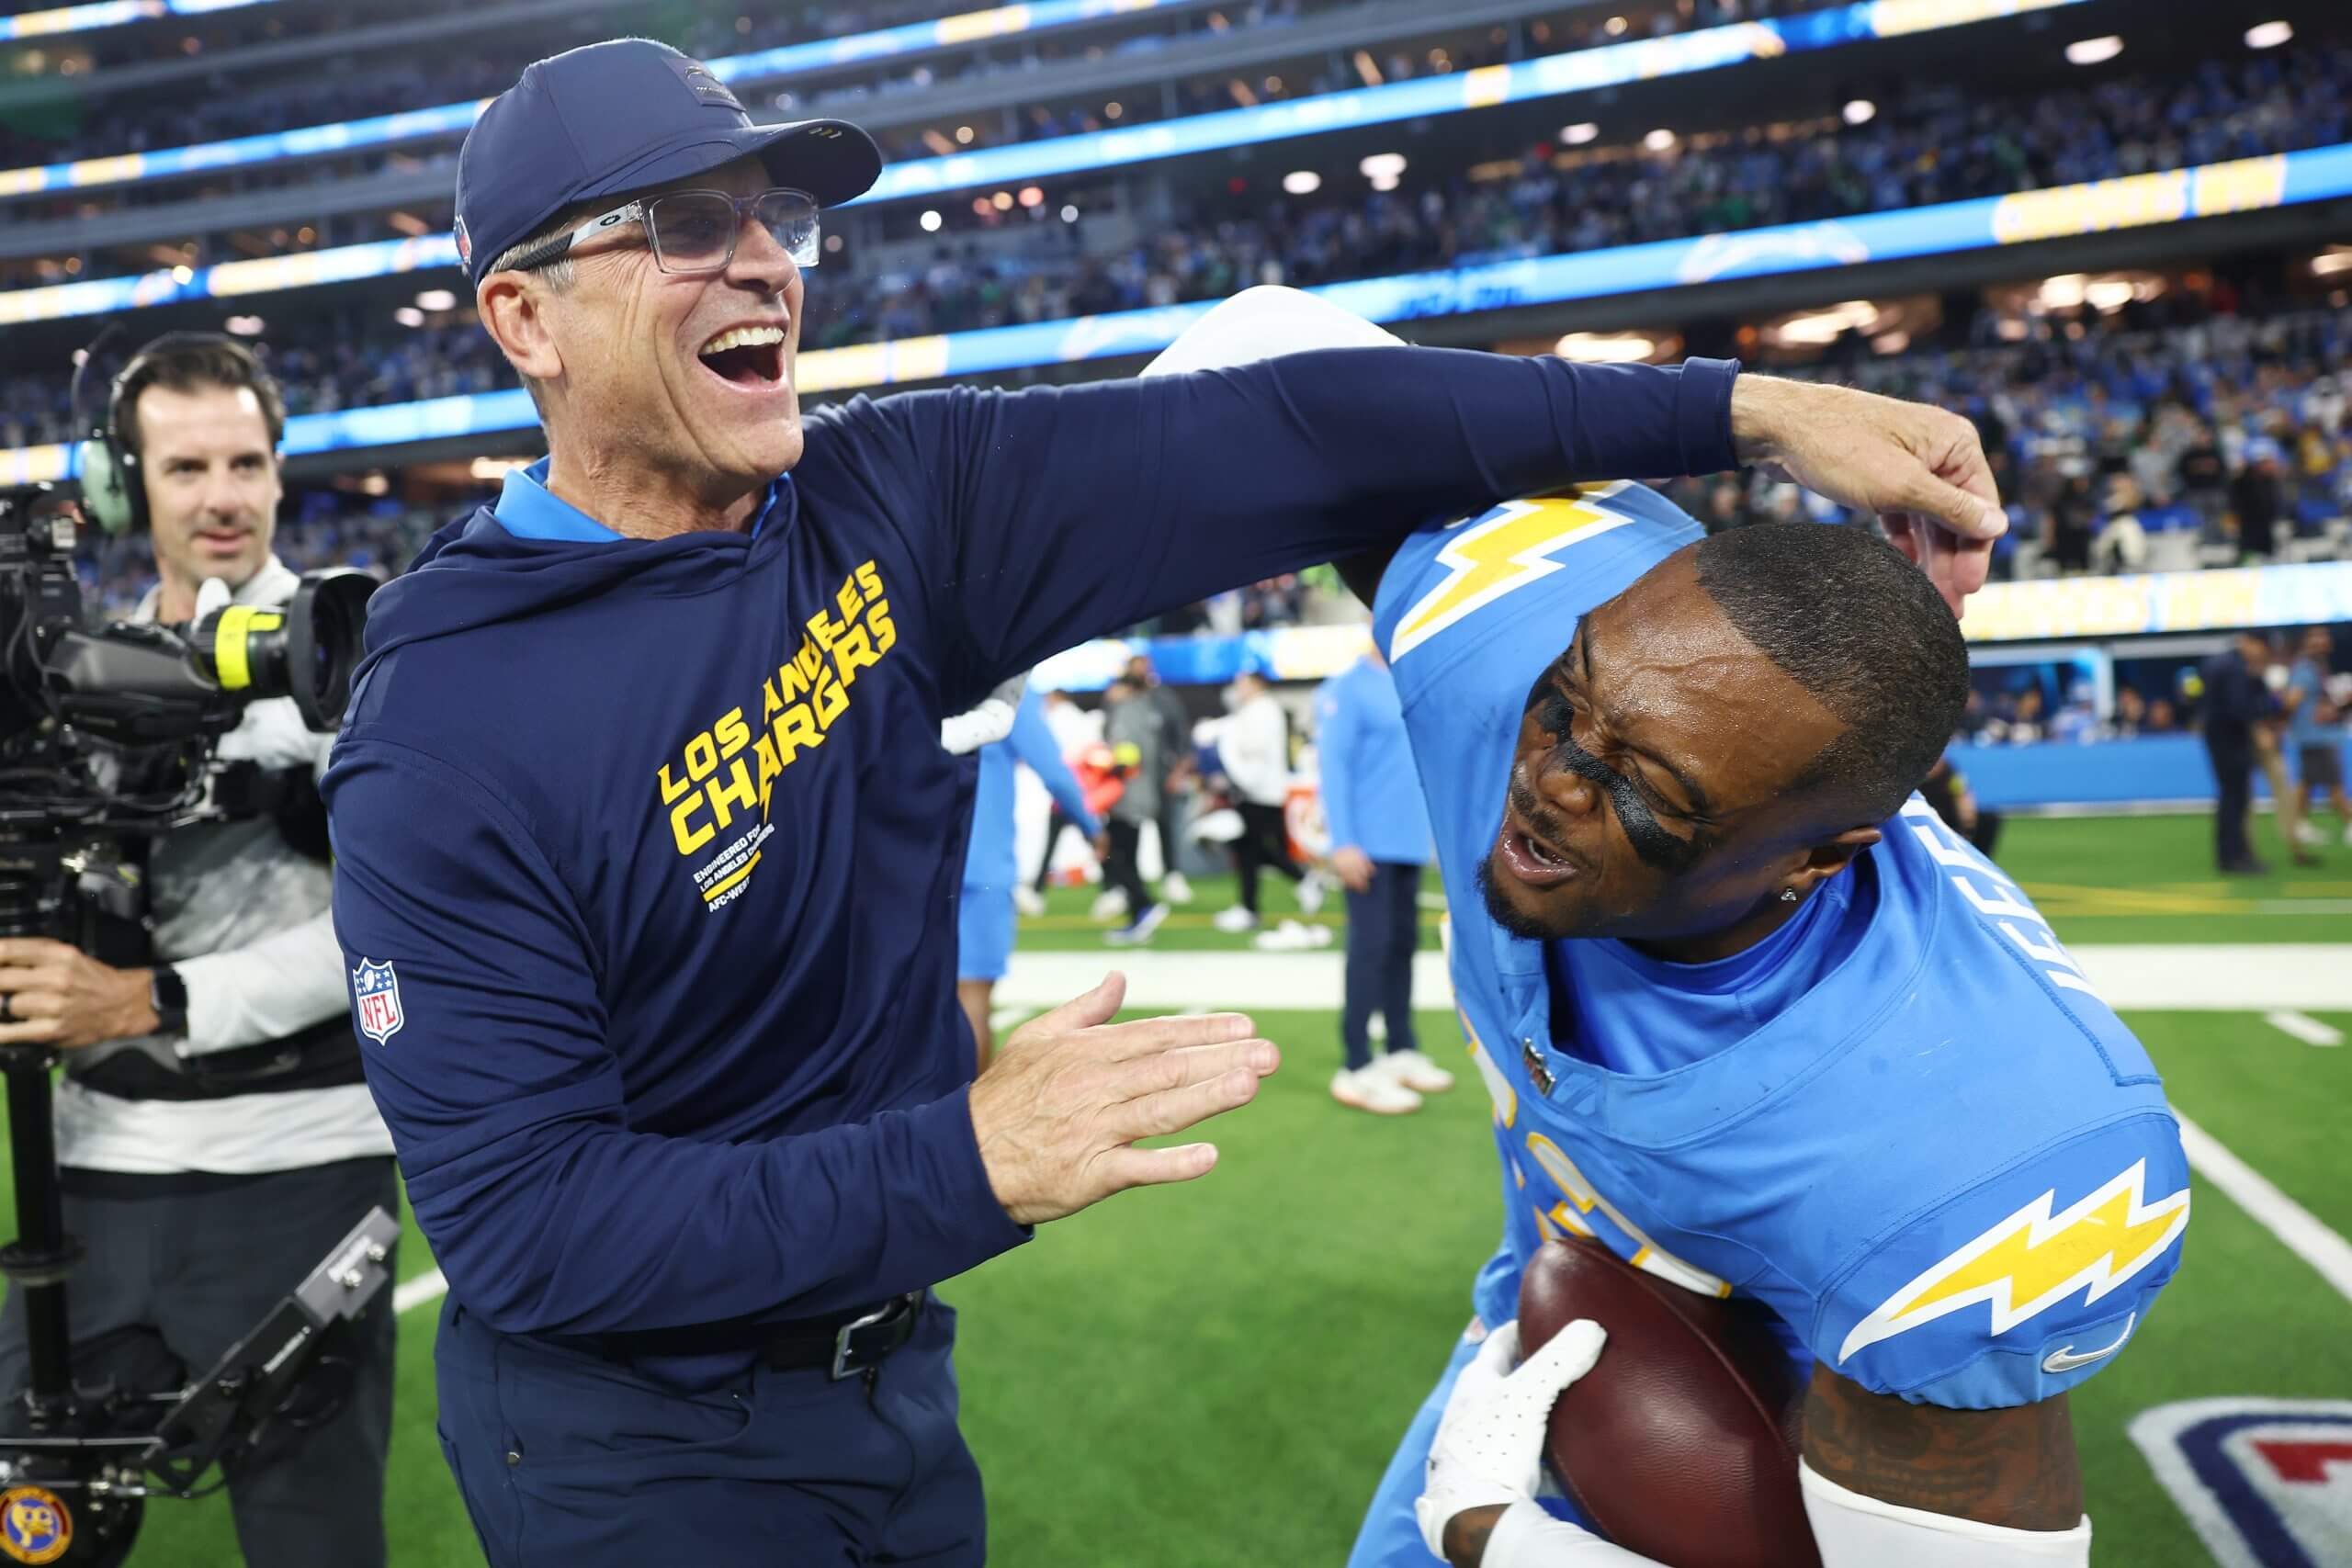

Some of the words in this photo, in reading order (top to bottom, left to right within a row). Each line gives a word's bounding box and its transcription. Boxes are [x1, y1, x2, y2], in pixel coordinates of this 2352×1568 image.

[670, 598, 897, 855] CHARGRS
[657, 705, 751, 806] LOS
[692, 837, 749, 883] ENGINEERED
[699, 875, 715, 892] LOS
[712, 852, 749, 882] ANGELES
[361, 993, 396, 1031] NFL
